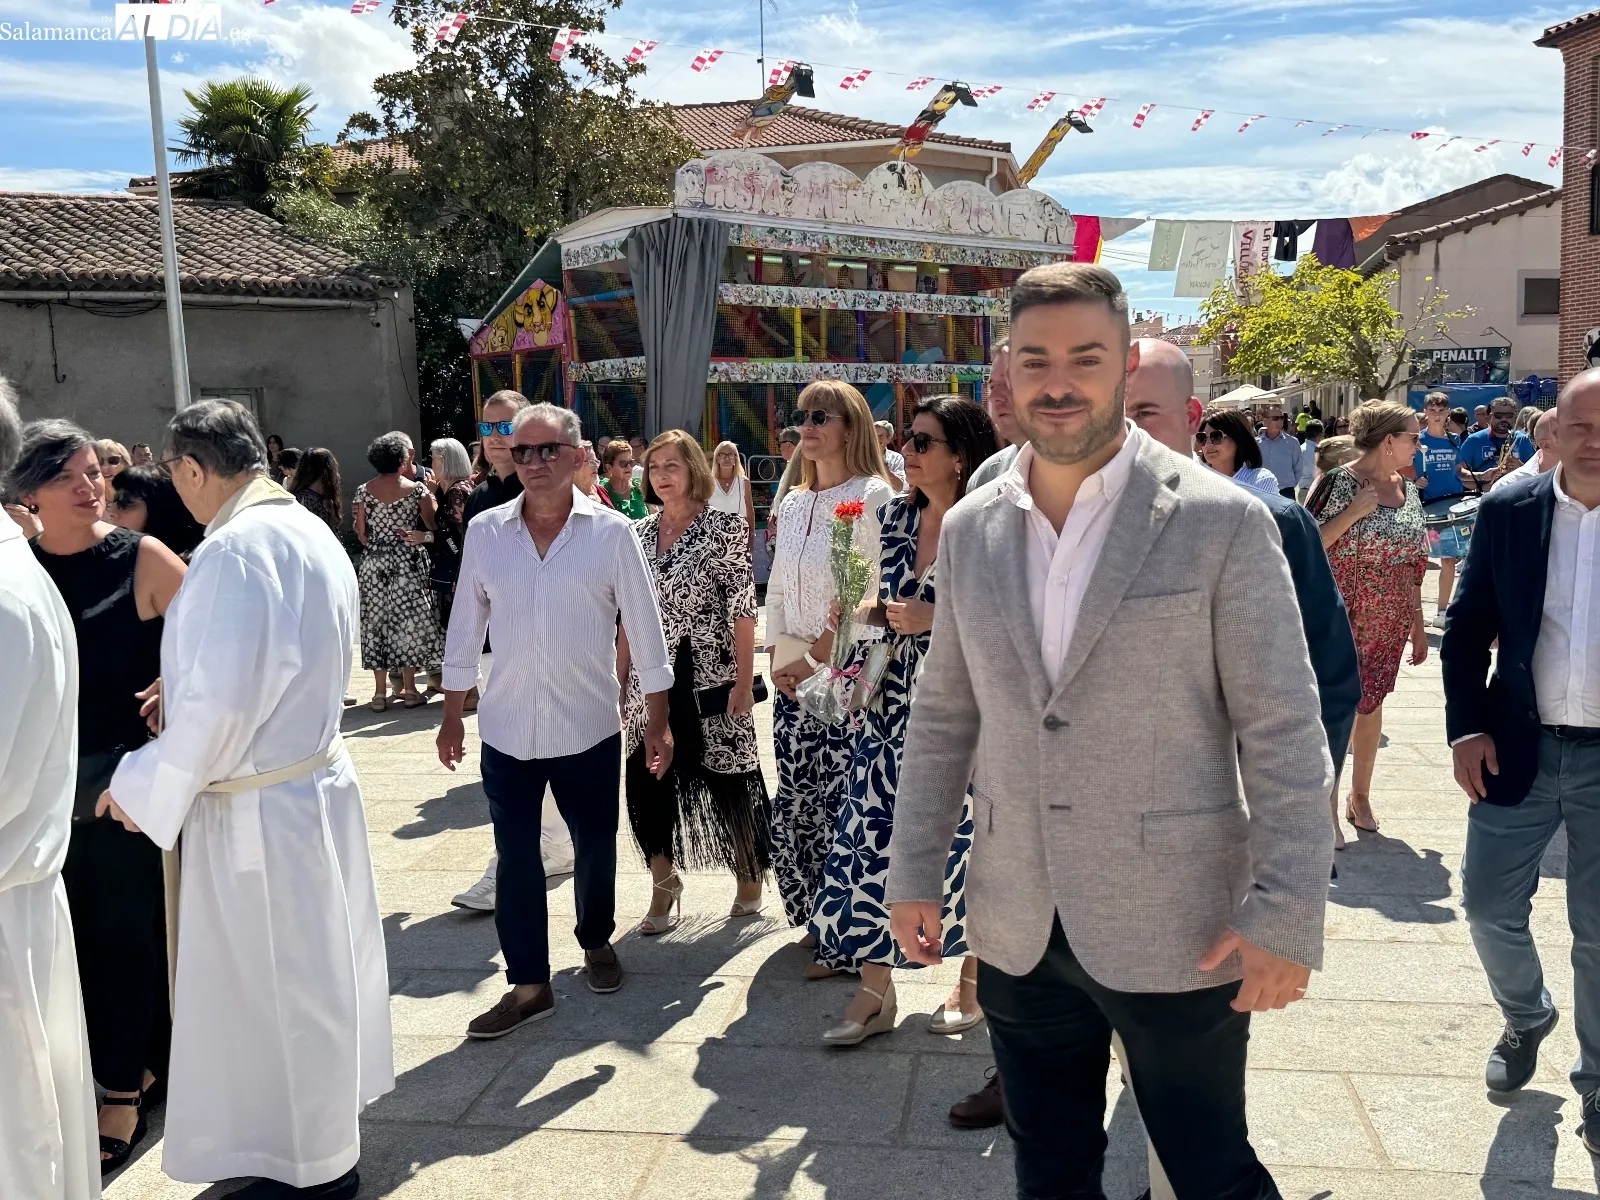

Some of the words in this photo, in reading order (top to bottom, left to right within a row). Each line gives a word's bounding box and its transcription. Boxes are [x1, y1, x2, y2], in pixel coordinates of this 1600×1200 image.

[1262, 227, 1272, 242] LA
[1432, 349, 1487, 362] PENALTI
[1425, 454, 1435, 462] LA
